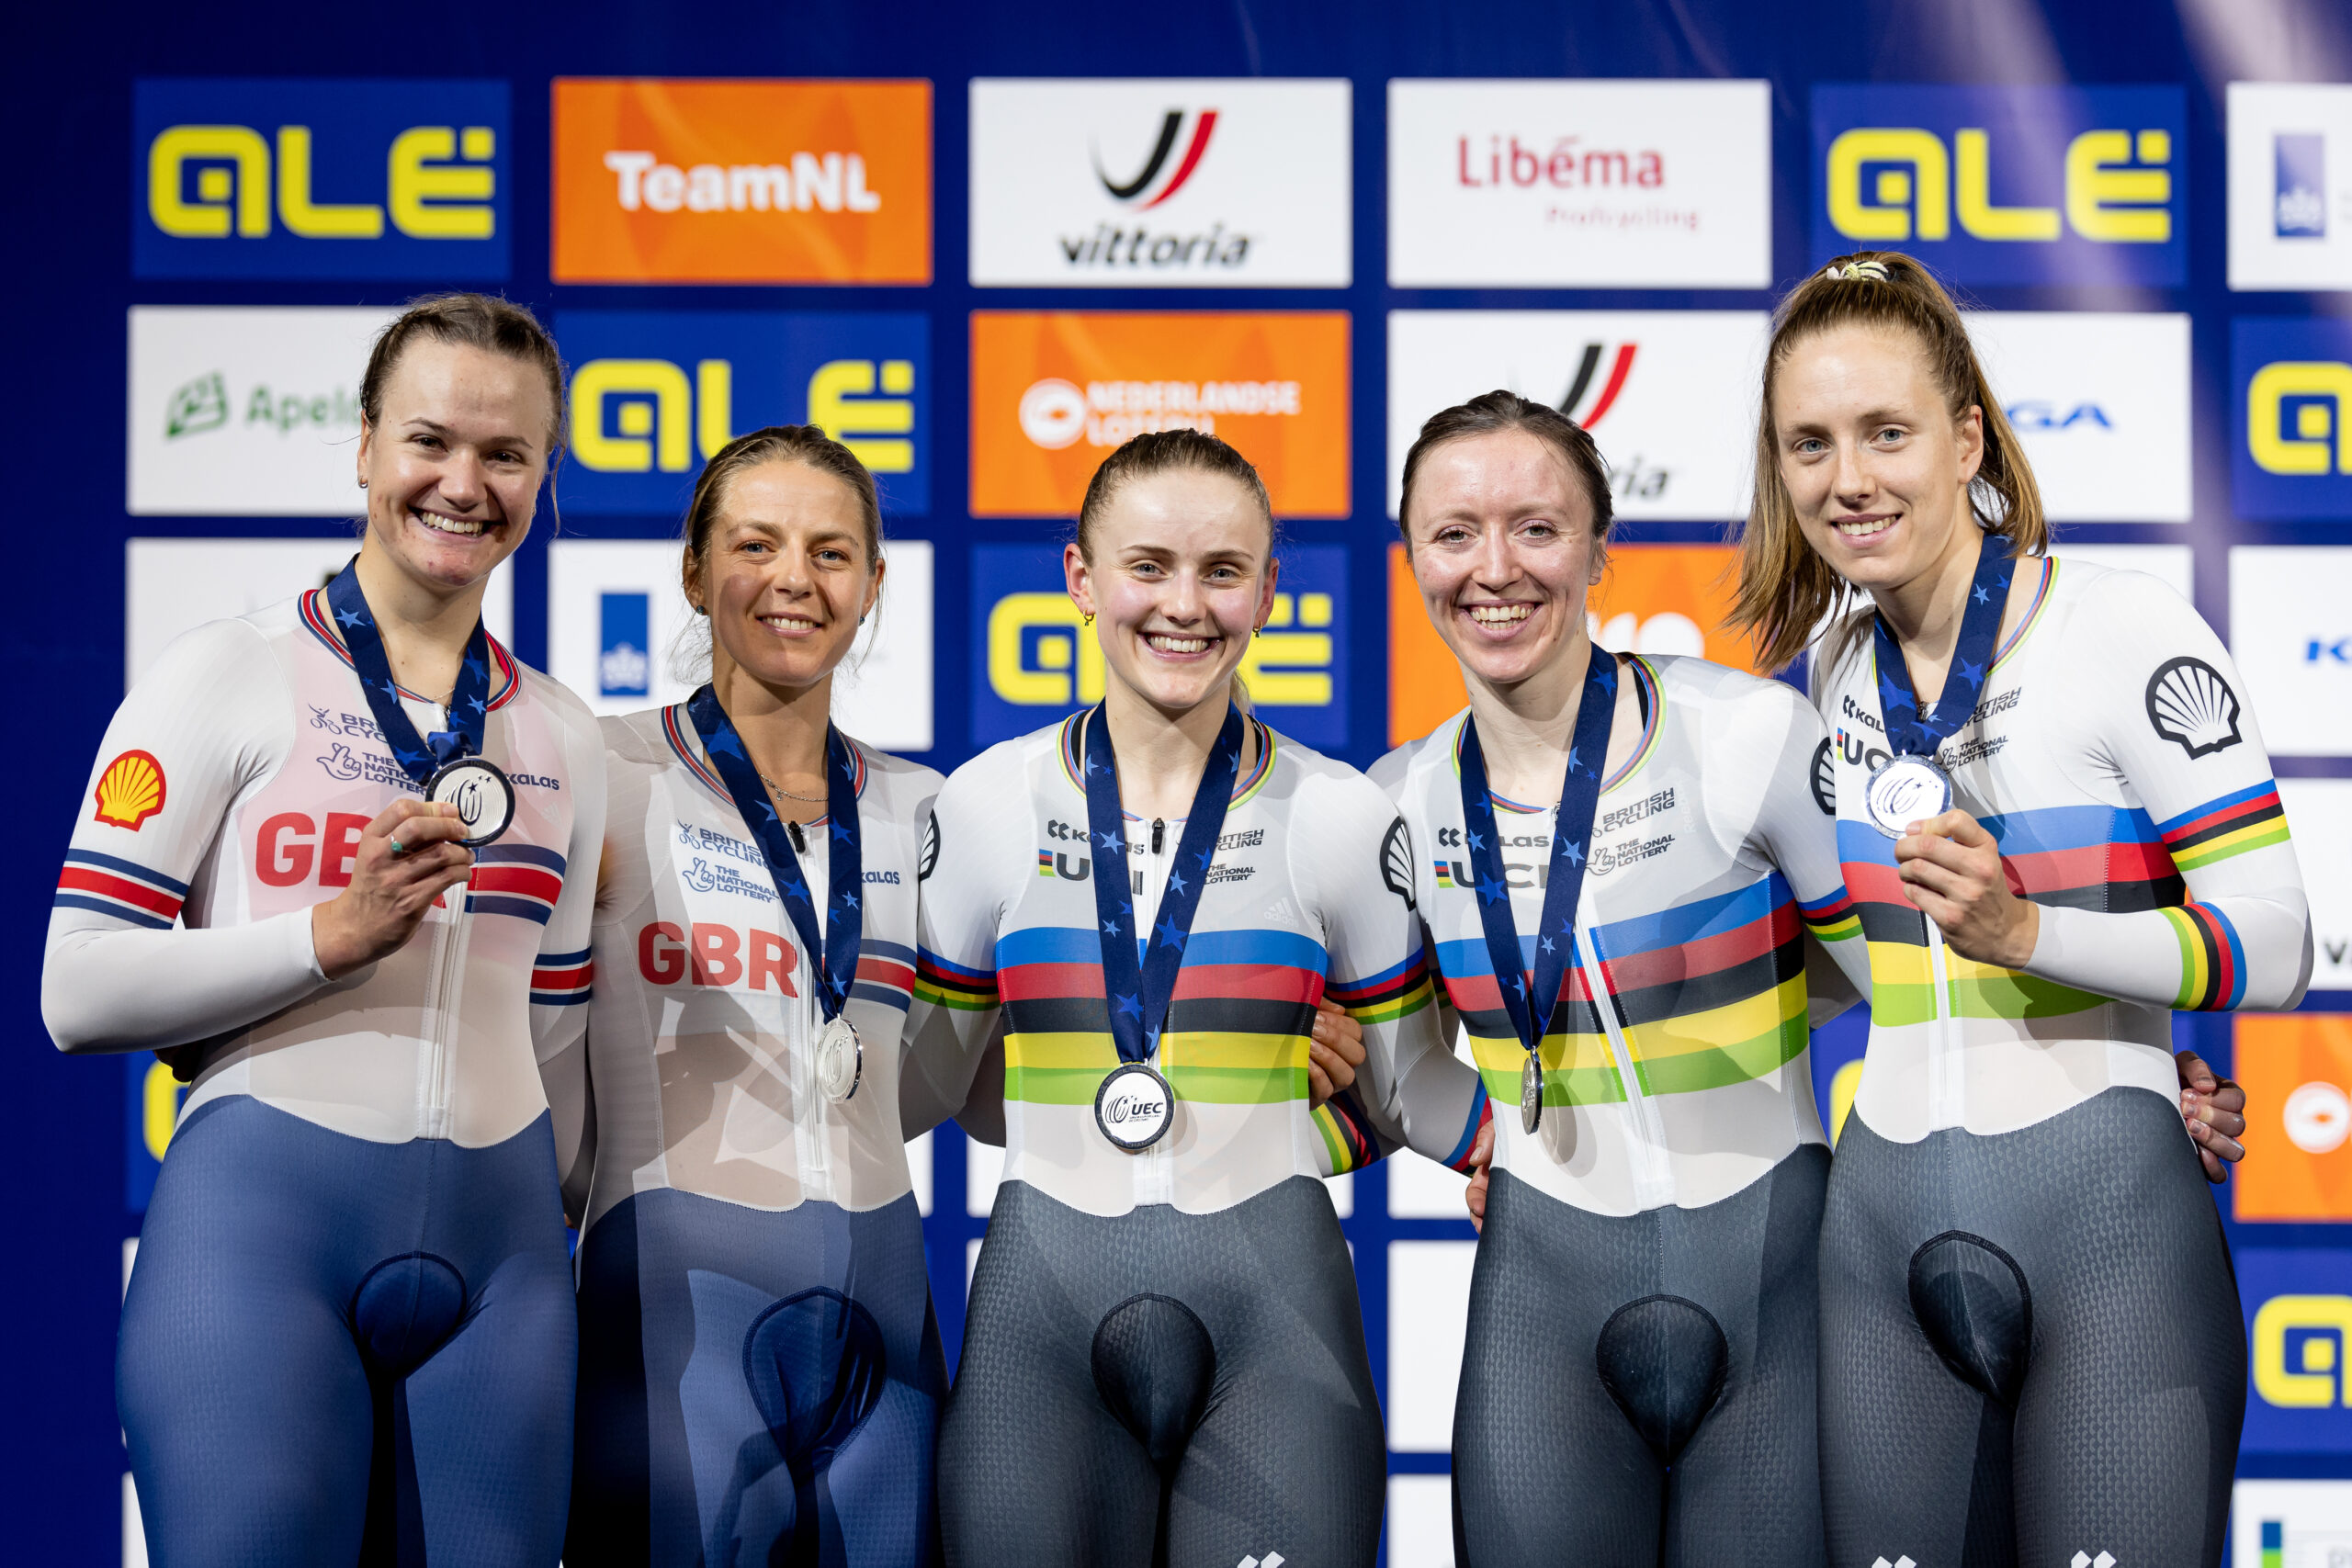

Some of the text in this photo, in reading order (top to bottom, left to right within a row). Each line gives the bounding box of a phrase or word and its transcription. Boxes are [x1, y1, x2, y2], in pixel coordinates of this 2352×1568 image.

[1456, 135, 1666, 188] Libéma
[605, 152, 880, 212] TeamNL
[1060, 221, 1250, 269] vittoria
[1086, 380, 1301, 416] NEDERLANDSE
[1844, 732, 1894, 773] UC
[1958, 745, 2002, 766] LOTTERY
[1959, 735, 2008, 759] NATIONAL
[1960, 737, 1980, 750] THE
[362, 751, 396, 767] THE
[365, 772, 425, 796] LOTTER
[1603, 786, 1675, 825] BRITISH
[1604, 796, 1675, 832] CYCLING
[699, 828, 762, 858] BRITIS
[1216, 829, 1264, 844] RITISH
[1216, 837, 1263, 851] CLING
[1615, 838, 1640, 852] THE
[1617, 834, 1676, 860] NATIONAL
[1618, 844, 1669, 867] LOTTERY
[715, 864, 741, 878] THE
[1057, 852, 1144, 896] UI
[1205, 874, 1250, 885] LOTTERY
[1206, 866, 1256, 878] NATIONAL
[717, 874, 780, 899] NATIONAL
[717, 883, 774, 903] LOTTERY
[639, 921, 798, 998] GBR
[1132, 1102, 1163, 1116] UEC
